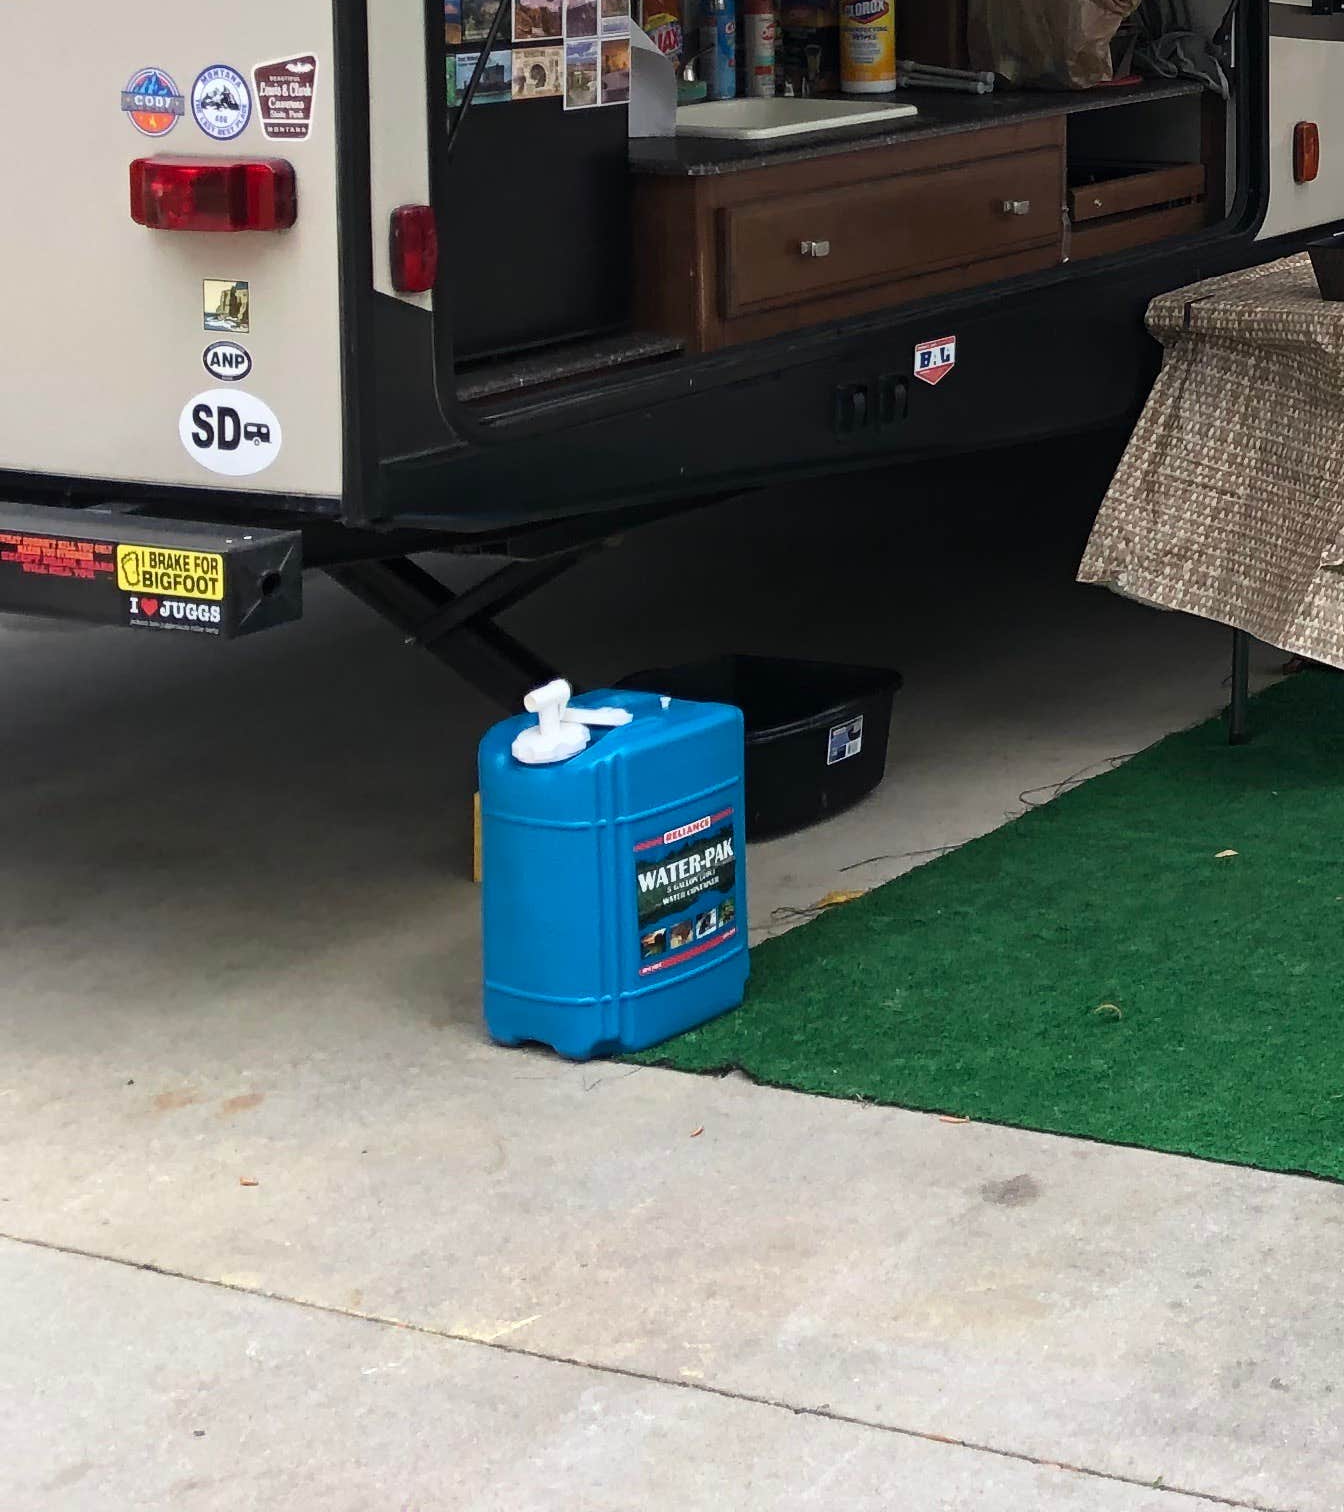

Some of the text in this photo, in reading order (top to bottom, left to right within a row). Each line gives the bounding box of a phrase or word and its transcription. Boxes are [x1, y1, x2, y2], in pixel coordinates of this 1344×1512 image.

[200, 68, 242, 88] MONTANA
[134, 95, 172, 108] CODY
[267, 126, 307, 134] MONTANA
[210, 351, 245, 369] ANP
[191, 403, 241, 451] SD
[141, 551, 219, 576] I BRAKE FOR
[142, 570, 219, 595] BIGFOOT
[129, 596, 221, 623] I JUGGS
[665, 817, 710, 842] RELIANCE
[638, 838, 734, 893] WATER-PAK
